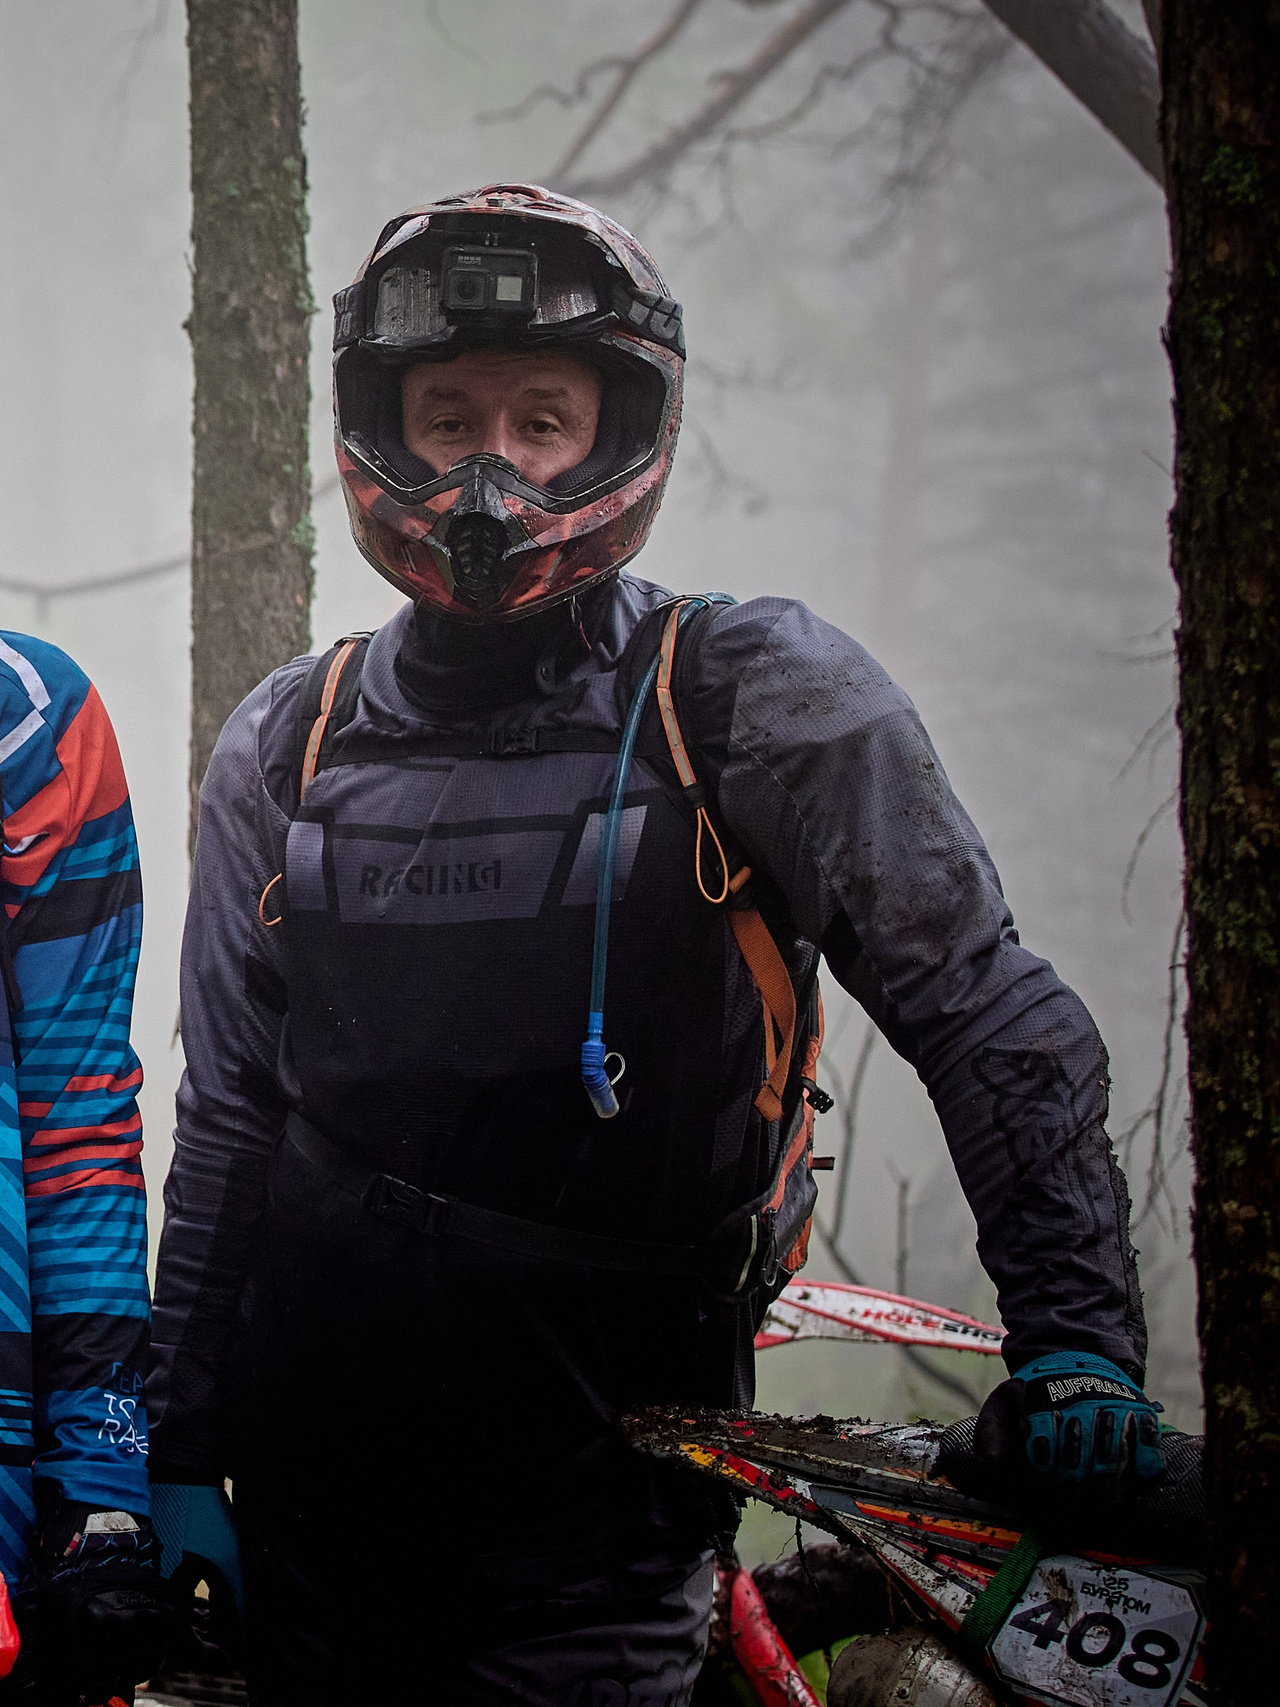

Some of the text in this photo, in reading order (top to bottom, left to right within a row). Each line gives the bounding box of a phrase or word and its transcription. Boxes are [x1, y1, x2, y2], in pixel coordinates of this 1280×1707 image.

[359, 859, 502, 898] RACING
[1046, 1376, 1137, 1402] AUFPRALL
[1008, 1598, 1181, 1690] 408
